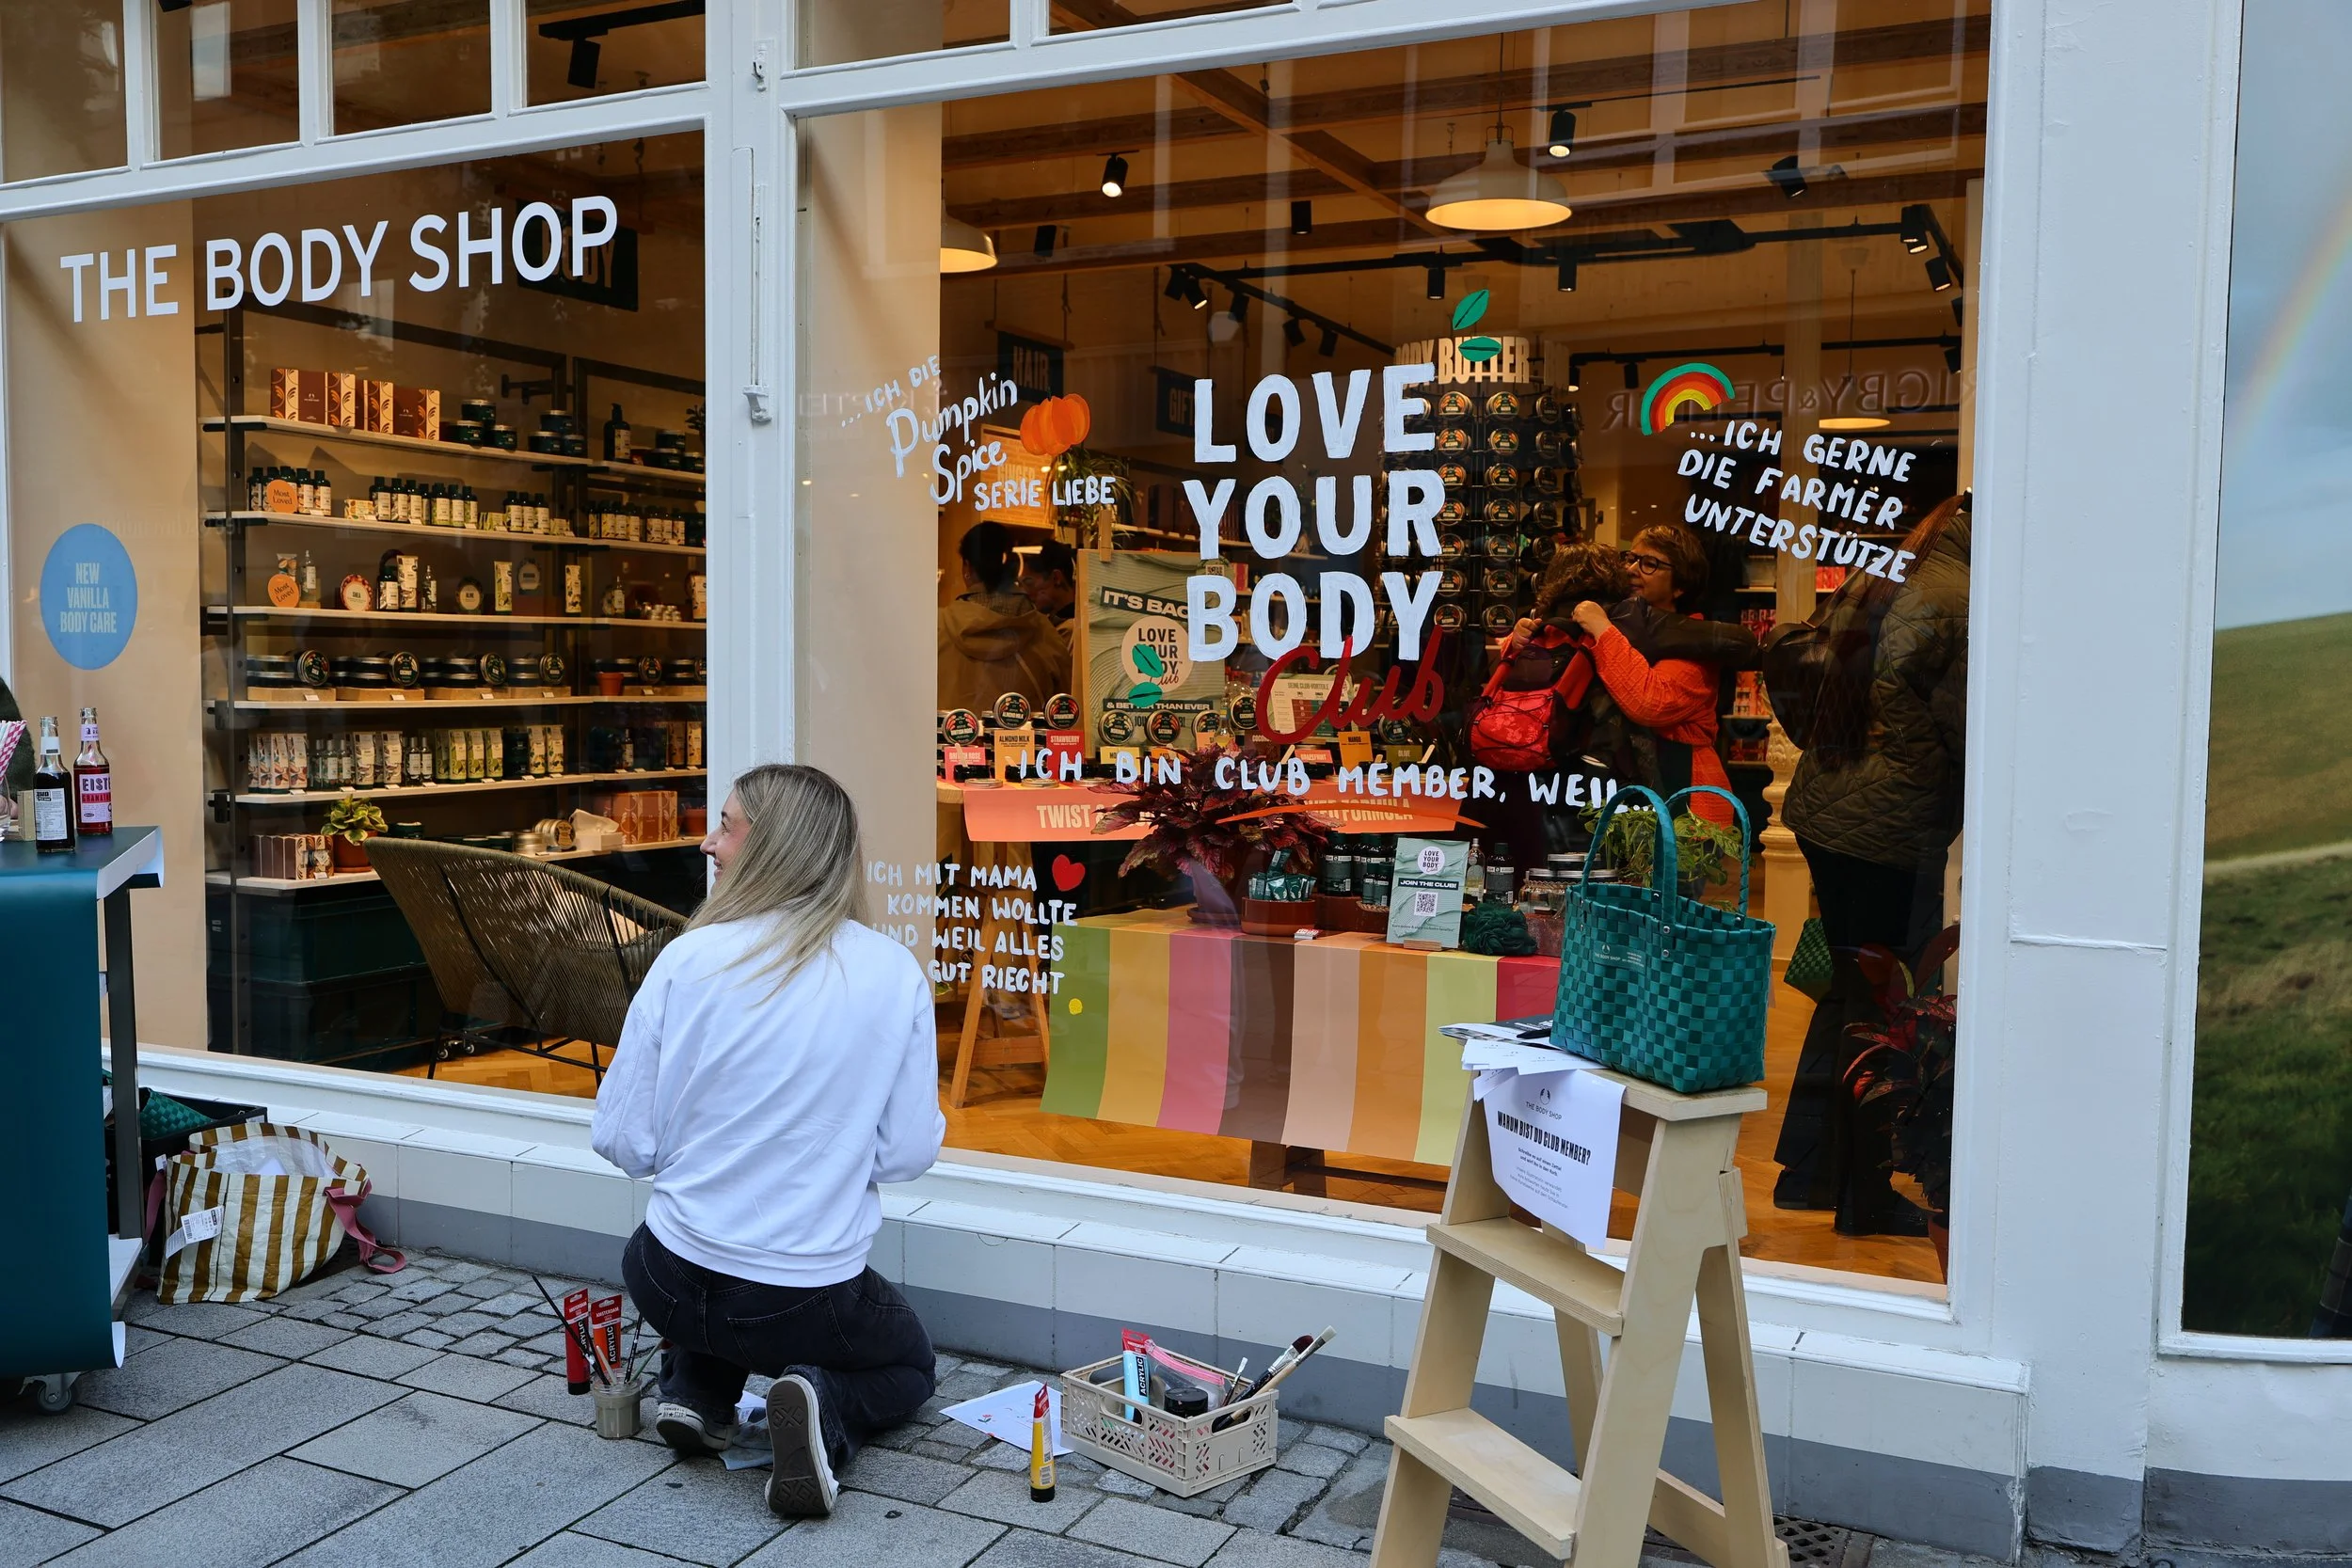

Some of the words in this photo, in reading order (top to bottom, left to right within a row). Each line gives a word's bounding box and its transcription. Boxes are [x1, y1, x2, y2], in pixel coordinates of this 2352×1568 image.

[60, 245, 179, 323] THE
[206, 220, 389, 311] BODY
[408, 196, 618, 293] SHOP
[908, 355, 941, 388] DIE
[1013, 345, 1049, 391] HAIR
[886, 372, 1018, 478] Pumpkin
[1194, 361, 1436, 463] LOVE
[930, 439, 1008, 505] Spice
[1804, 434, 1916, 483] GERNE
[272, 495, 293, 506] Loved
[273, 488, 290, 499] Most
[974, 479, 1041, 511] SERIE
[1052, 476, 1117, 506] LIEBE
[1677, 449, 1737, 489] DIE
[1755, 469, 1903, 531] FARMER
[1181, 469, 1446, 561] YOUR
[1684, 493, 1917, 583] UNTERSTÜTZE
[75, 562, 100, 584] NEW
[274, 582, 289, 595] Most
[67, 587, 109, 609] VANILLA
[276, 590, 294, 603] Loved
[1104, 591, 1143, 610] IT'S
[1147, 599, 1188, 618] BAC
[60, 612, 87, 633] BODY
[89, 612, 117, 633] CARE
[1186, 570, 1443, 662] BODY
[1138, 628, 1176, 642] LOVE
[1140, 644, 1178, 658] OUR
[1138, 661, 1178, 674] DY
[1255, 624, 1444, 745] Club
[1051, 735, 1080, 743] STRAWBERRY
[1020, 748, 1083, 782] ICH
[1116, 750, 1183, 785] BIN
[1215, 757, 1310, 796] CLUB
[1338, 762, 1505, 803] MEMBER,
[1037, 804, 1090, 829] TWIST
[866, 861, 902, 887] ICH
[914, 863, 961, 886] MIT
[970, 864, 1037, 892] MAMA
[887, 894, 980, 920] KOMMEN
[992, 898, 1078, 927] WOLLTE
[931, 927, 986, 953] WEIL
[994, 930, 1064, 962] ALLES
[927, 959, 972, 984] GUT
[981, 964, 1065, 994] RIECHT
[1526, 1101, 1534, 1111] THE
[1535, 1105, 1549, 1116] BODY
[1549, 1110, 1562, 1120] SHOP
[1497, 1110, 1518, 1134] WARUM
[1518, 1119, 1534, 1140] BIST
[1534, 1126, 1543, 1145] DU
[1543, 1131, 1560, 1152] CLUB
[1560, 1138, 1592, 1165] MEMBER?
[596, 1307, 619, 1318] AMSTERDAM
[579, 1320, 587, 1349] RYLIC
[607, 1325, 616, 1362] ACRYLIC
[1136, 1357, 1147, 1395] ACRYLIC
